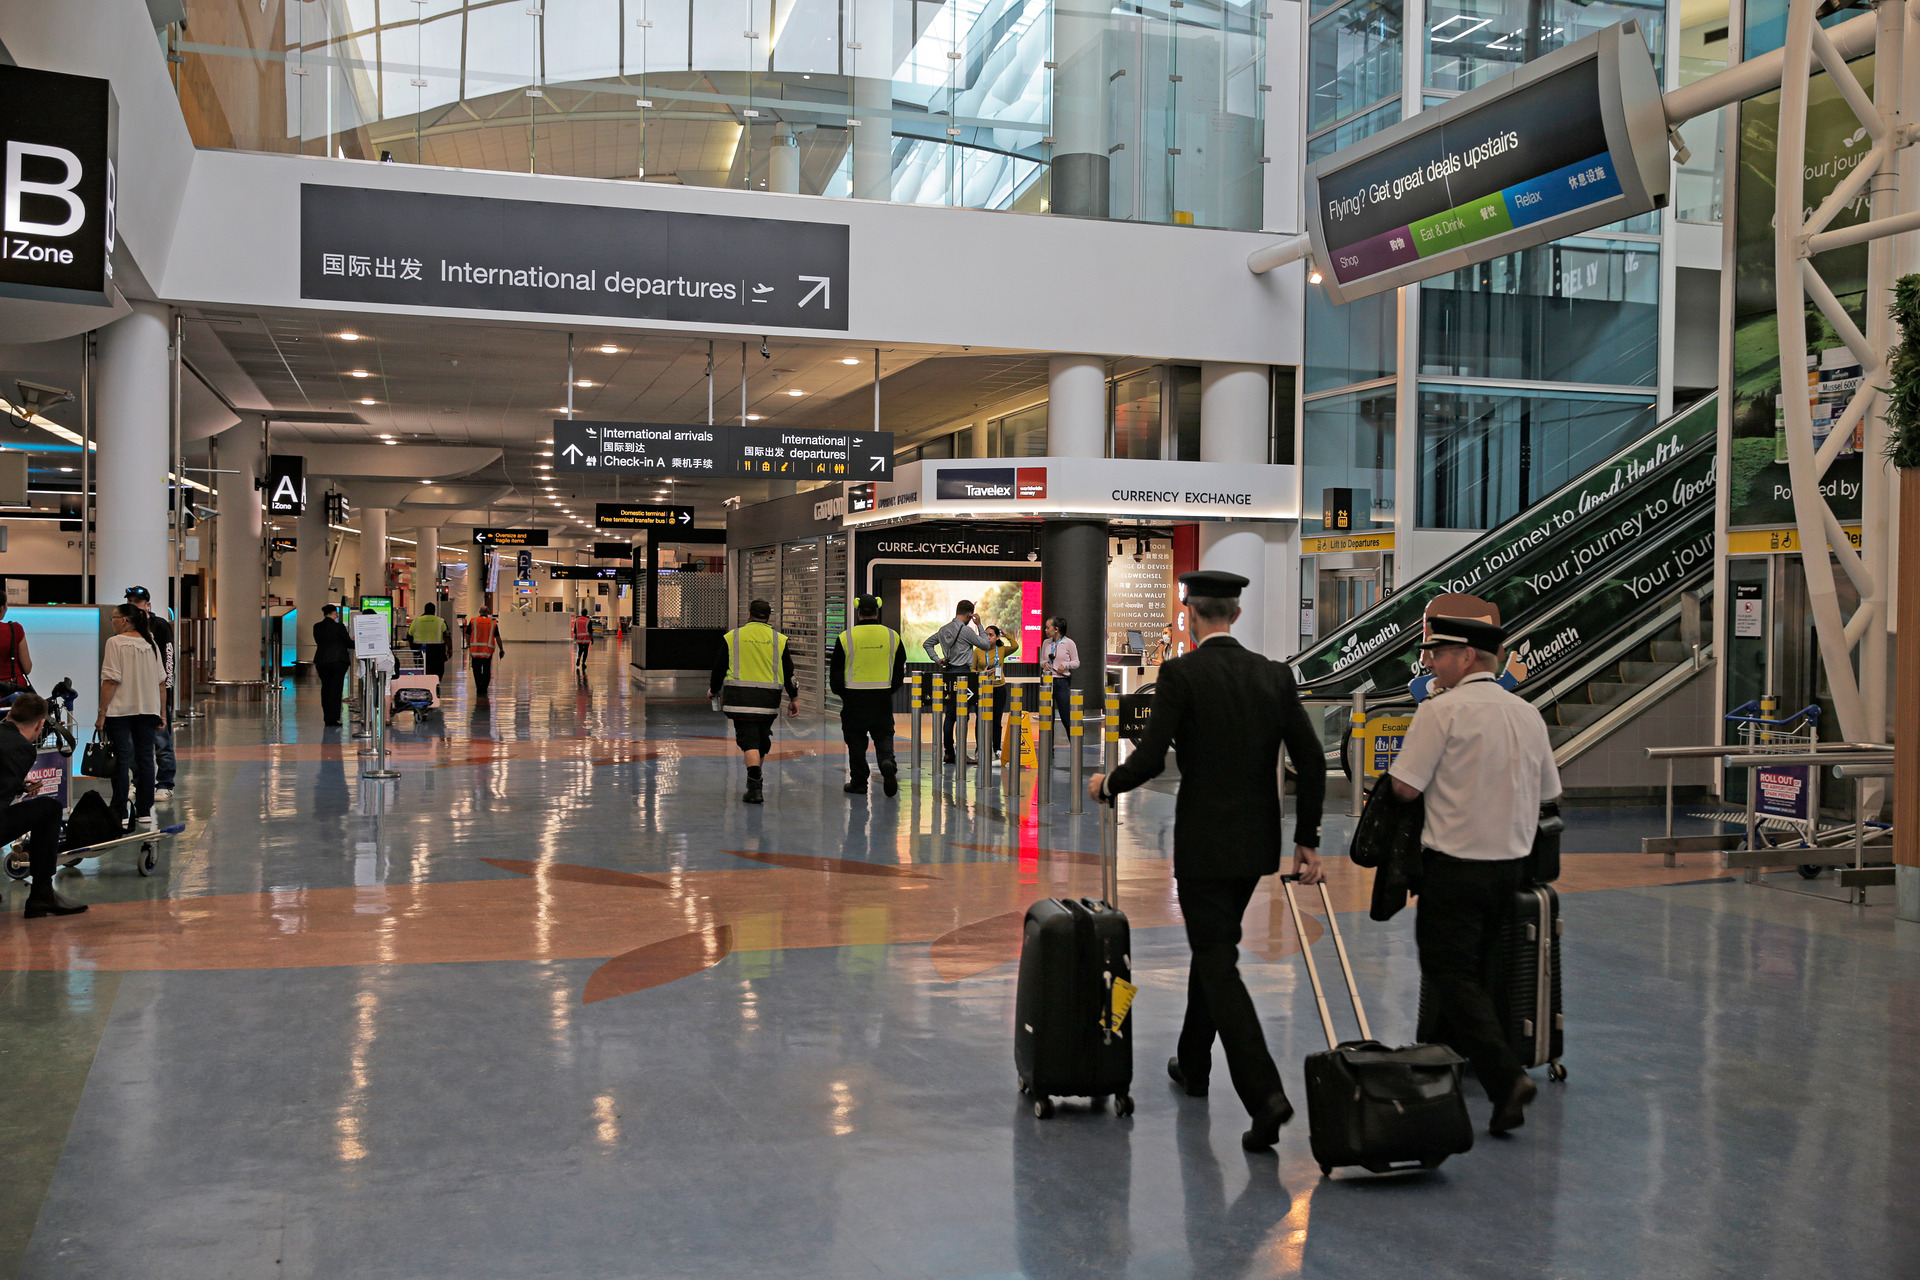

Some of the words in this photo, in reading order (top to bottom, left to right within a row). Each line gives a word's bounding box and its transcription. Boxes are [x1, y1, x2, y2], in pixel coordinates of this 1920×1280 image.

[1329, 188, 1366, 222] Flying?
[1369, 180, 1391, 204] Get
[1393, 166, 1424, 200] great
[1426, 152, 1461, 182] deals
[1463, 131, 1519, 169] upstairs
[1568, 166, 1607, 190] 休息设施
[1803, 162, 1830, 180] our
[4, 140, 86, 237] B
[1514, 191, 1542, 209] Relax
[1480, 205, 1497, 221] 餐饮
[1420, 227, 1435, 242] Eat
[1436, 224, 1443, 237] &
[1443, 217, 1466, 234] Drink
[12, 239, 74, 264] Zone
[1389, 237, 1405, 251] 购物
[323, 253, 423, 281] 国际出发
[1340, 254, 1359, 269] Shop
[441, 259, 596, 291] International
[604, 271, 737, 299] departures
[1822, 383, 1843, 392] Mussel
[604, 427, 671, 441] International
[674, 430, 713, 442] arrivals
[782, 434, 846, 446] International
[604, 442, 645, 453] 国际到达
[744, 446, 785, 457] 国际出发
[790, 448, 846, 461] departures
[604, 456, 653, 467] Check-in
[657, 457, 665, 467] A
[672, 457, 713, 469] 乘机手续
[272, 475, 299, 502] A
[965, 485, 1011, 496] Travelex
[1774, 480, 1837, 500] Poed
[1841, 480, 1860, 500] by
[1112, 490, 1179, 503] CURRENCY
[1185, 492, 1252, 505] EXCHANGE
[1440, 566, 1481, 594] Your
[1553, 509, 1574, 529] to
[1626, 435, 1684, 482] Health
[1525, 565, 1570, 596] Your
[1571, 516, 1643, 576] journey
[1645, 499, 1667, 520] to
[1672, 455, 1717, 508] Good
[877, 542, 937, 554] CURRENCY
[941, 543, 999, 554] EXCHANGE
[1330, 540, 1340, 549] Lift
[1341, 540, 1347, 548] to
[1348, 538, 1380, 549] Departures
[1623, 562, 1670, 600] Your
[1544, 656, 1557, 667] NEW
[1558, 640, 1582, 658] ZEALAND
[43, 768, 56, 777] OUT
[1760, 774, 1777, 783] ROLL
[1778, 776, 1793, 785] OUT
